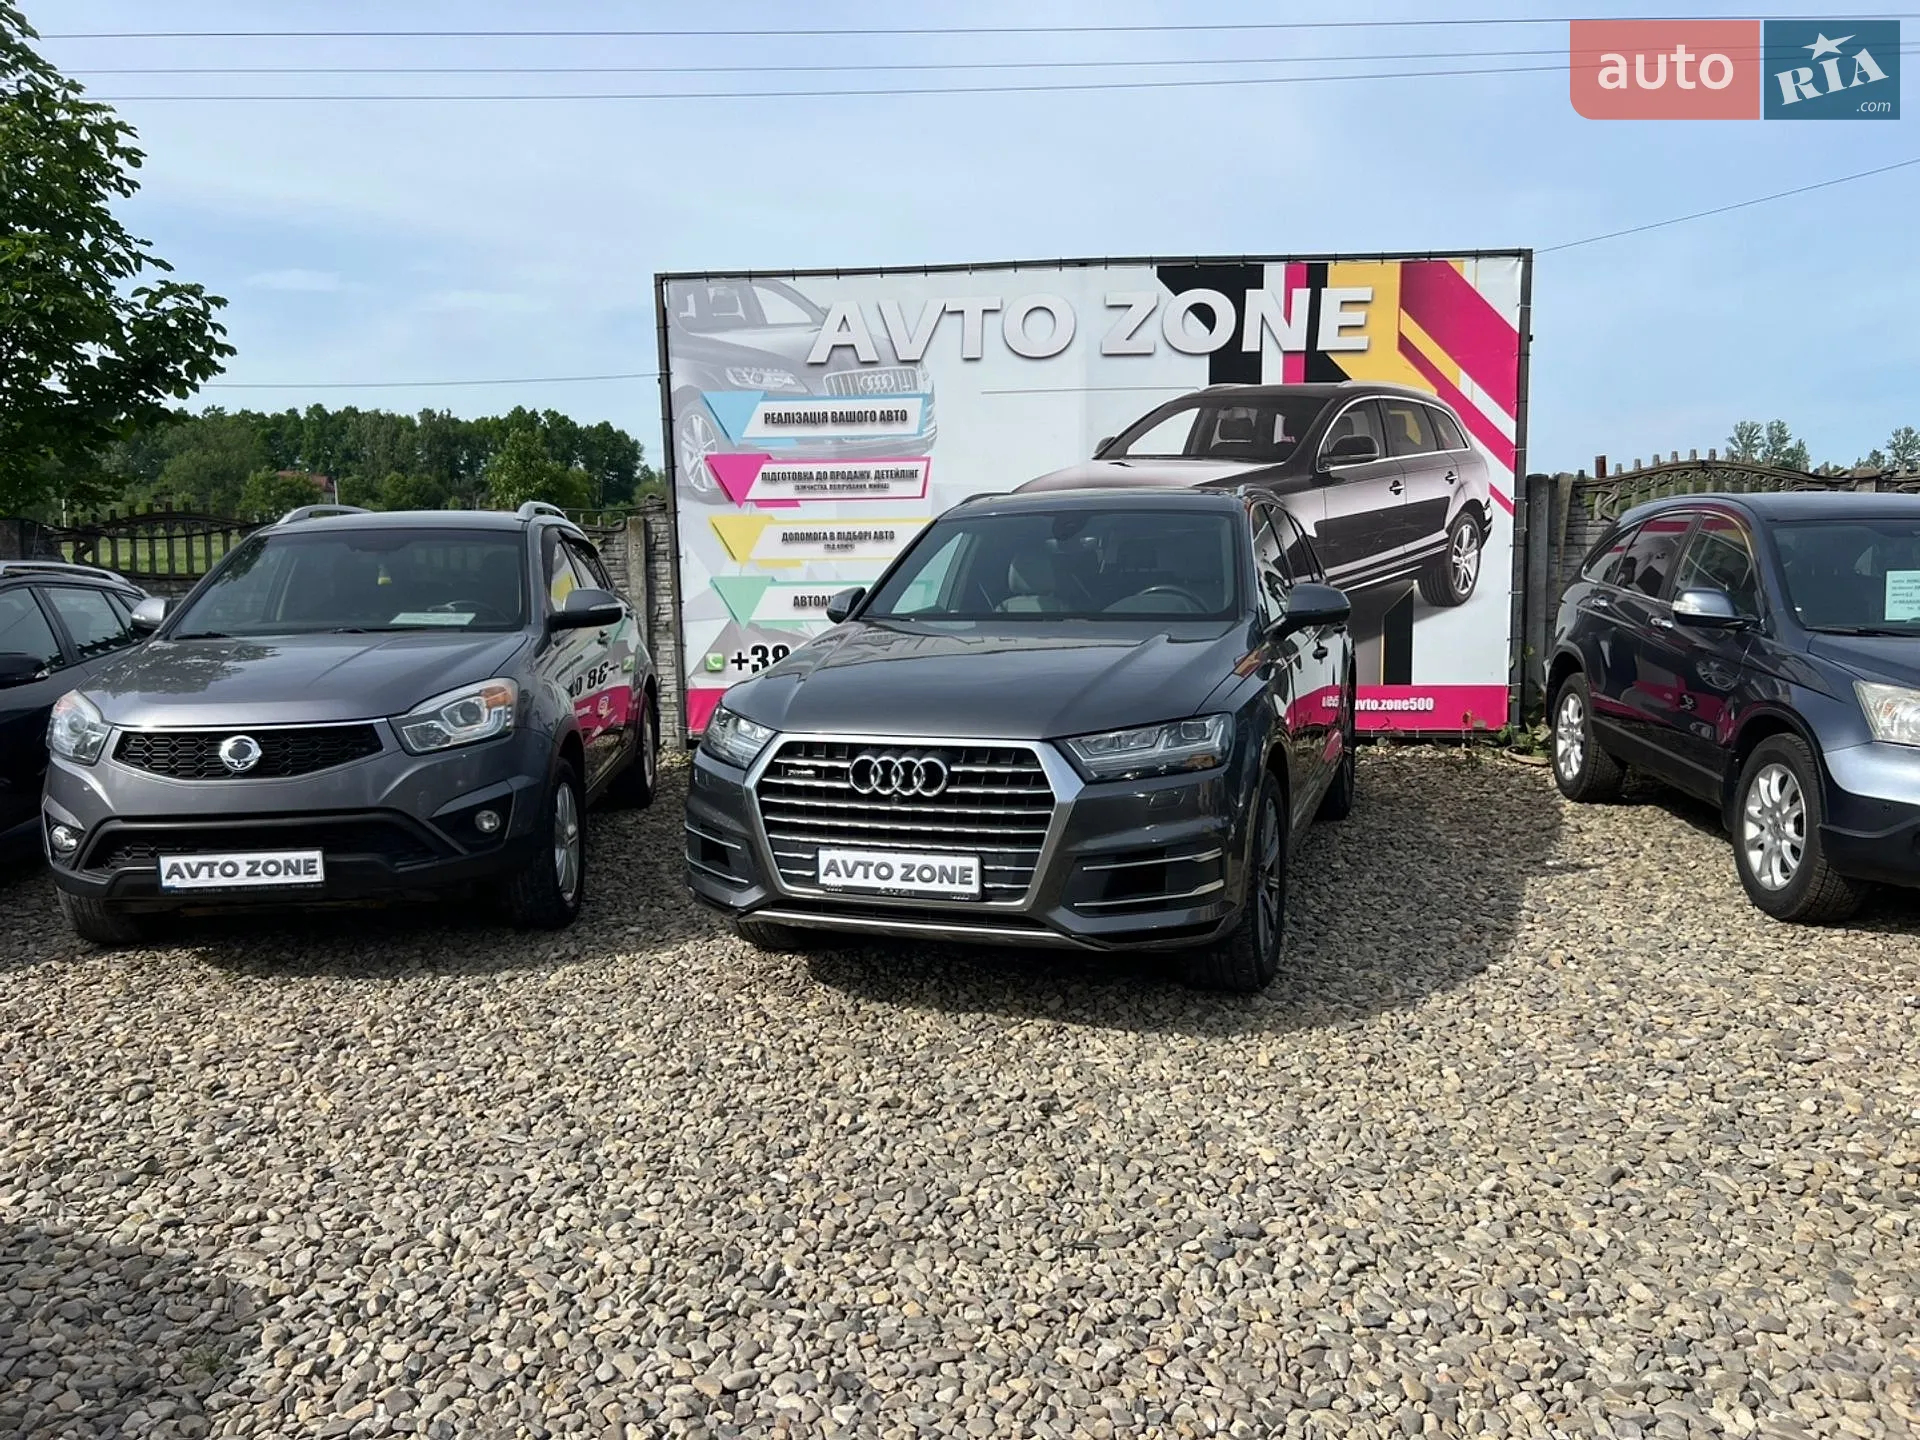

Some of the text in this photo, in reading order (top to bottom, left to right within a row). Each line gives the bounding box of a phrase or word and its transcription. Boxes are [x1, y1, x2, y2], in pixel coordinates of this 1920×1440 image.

[806, 286, 1374, 364] AVTO ZONE
[764, 409, 908, 426] РЕАЛІЗАЦІЯ ВАШОГО АВТО
[761, 470, 814, 482] ПІДГОТОВКА
[816, 470, 828, 482] ДО
[873, 467, 919, 481] ДЕТЕЙЛІНГ
[781, 530, 895, 543] ДОПОМОГА В ПІДБОРІ АВТО
[165, 858, 318, 880] AVTO ZONE
[822, 858, 974, 886] AVTO ZONE
